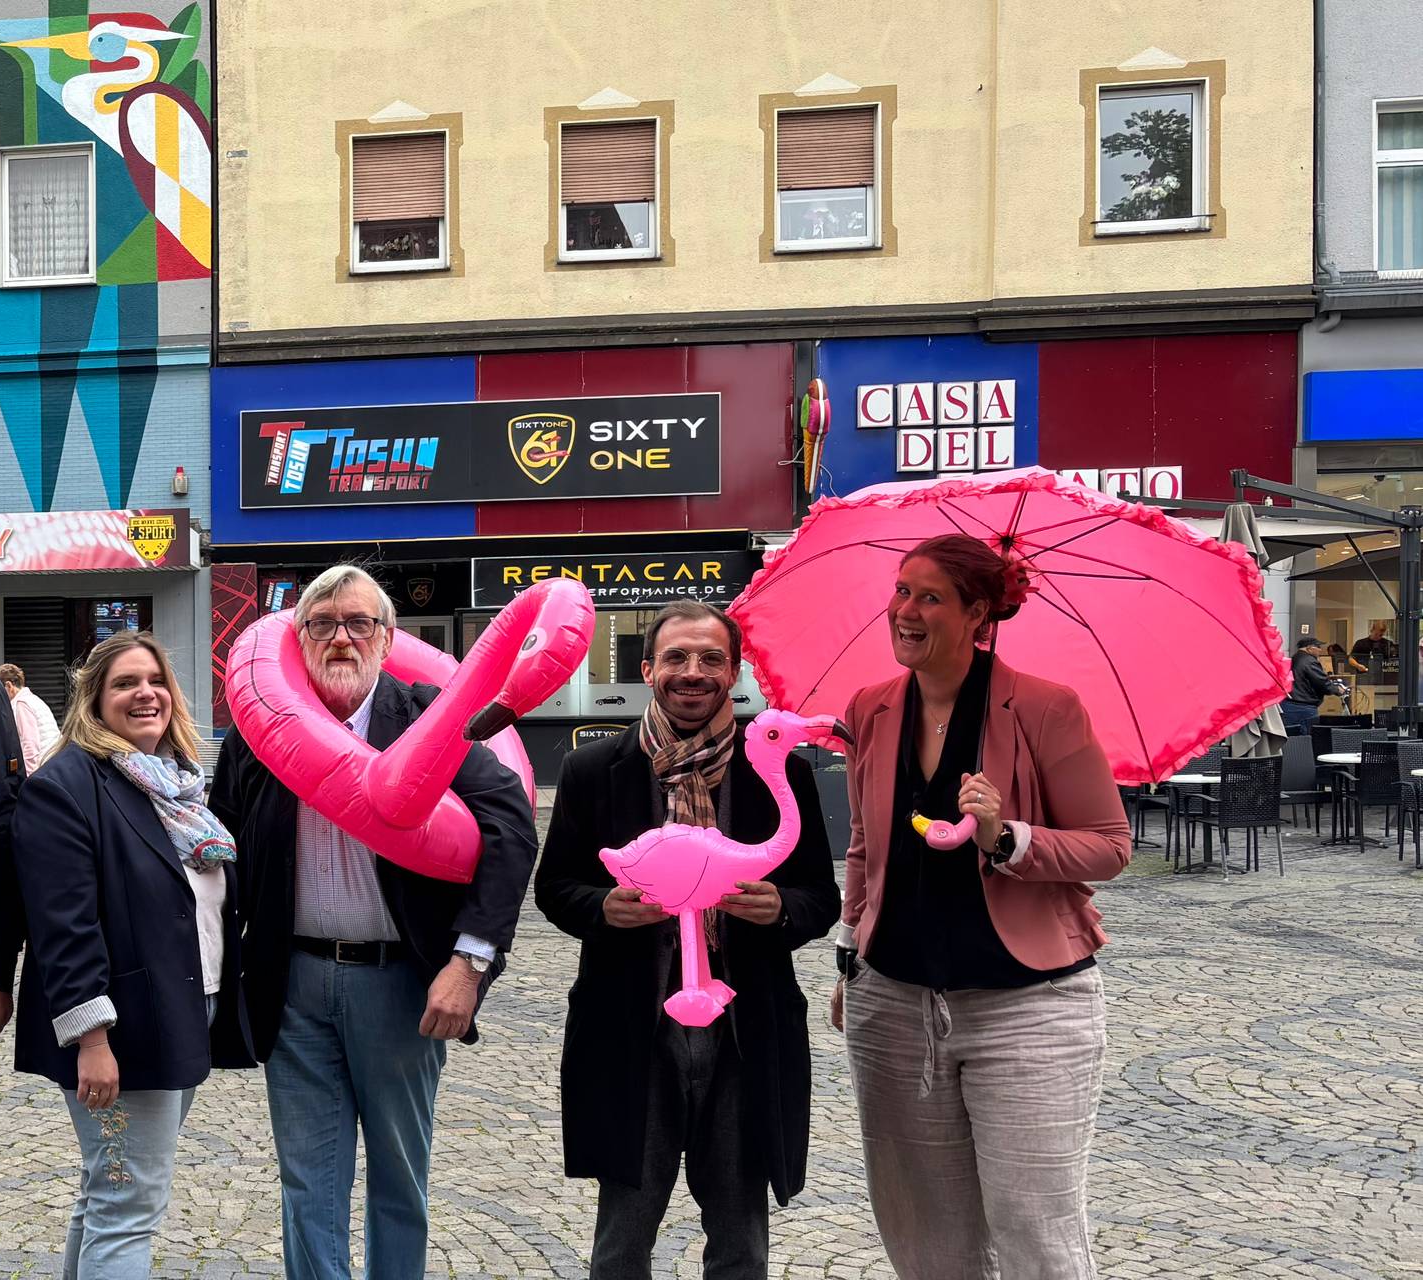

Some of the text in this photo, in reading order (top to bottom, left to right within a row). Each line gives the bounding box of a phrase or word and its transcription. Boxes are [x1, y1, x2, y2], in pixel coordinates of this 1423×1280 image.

[860, 382, 1012, 423] CASA
[515, 420, 568, 429] SIXTYONE
[589, 417, 706, 442] SIXTY
[266, 430, 288, 485] TRANSPORT
[328, 428, 439, 474] TOSUN
[520, 430, 557, 468] 61
[589, 448, 671, 470] ONE
[901, 430, 1010, 467] DEL
[285, 438, 311, 491] TOSUN
[329, 473, 433, 493] TRANSPORT
[138, 526, 175, 539] SPORT
[503, 561, 722, 584] RENTACAR
